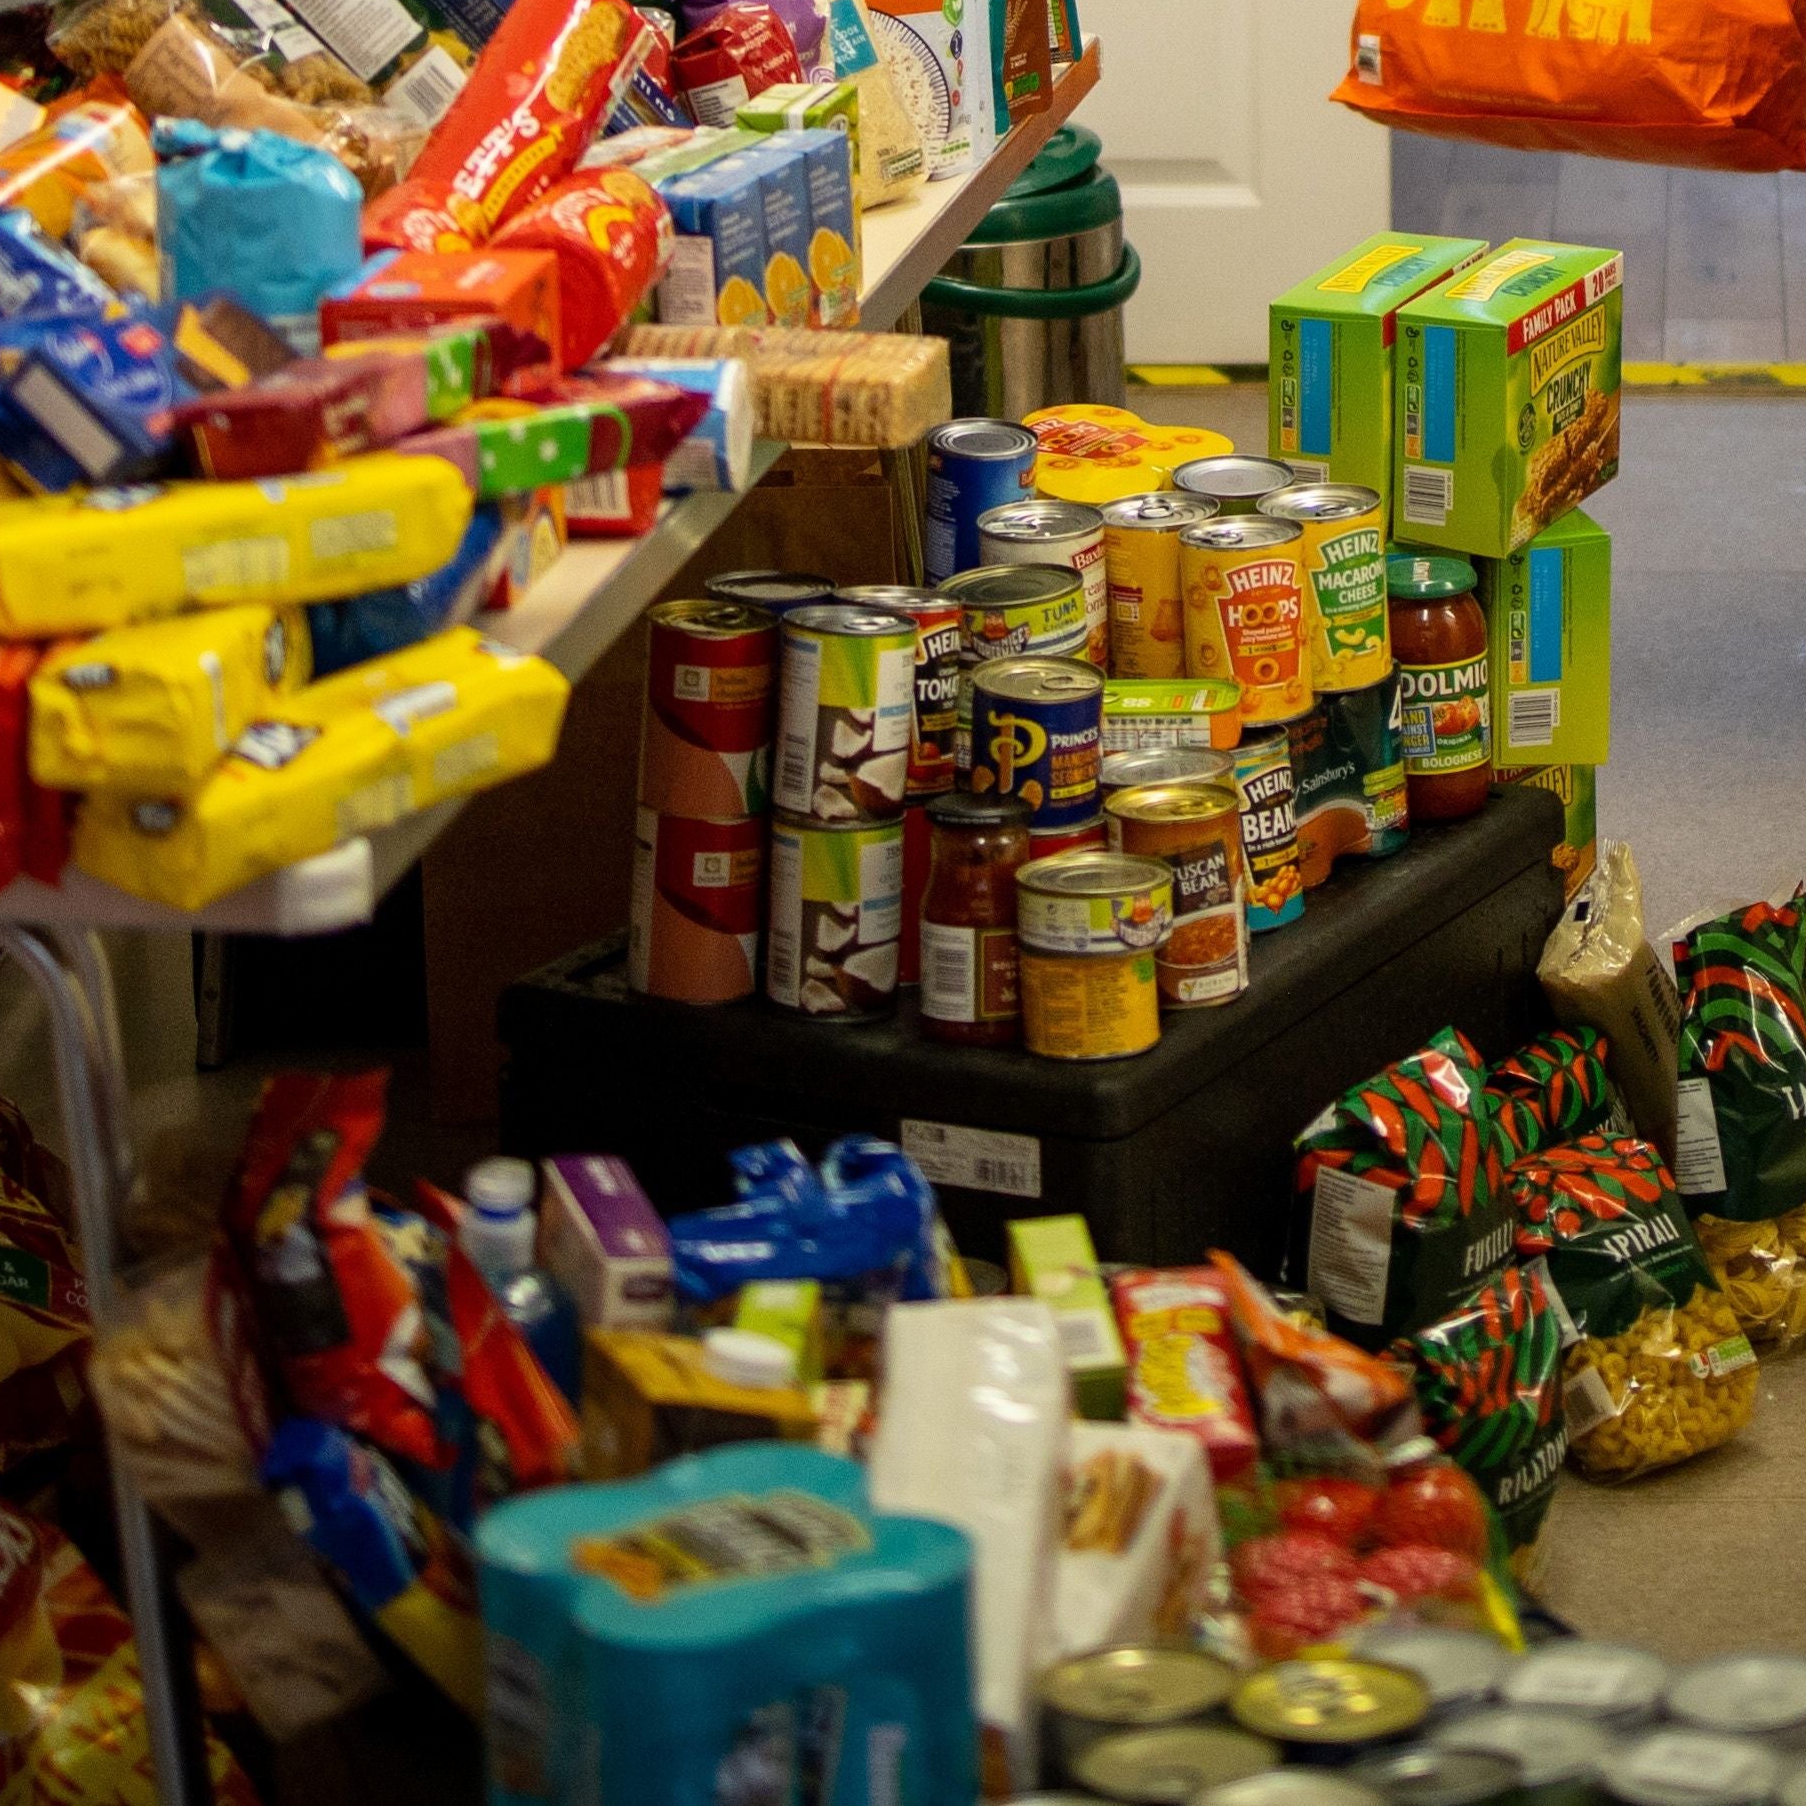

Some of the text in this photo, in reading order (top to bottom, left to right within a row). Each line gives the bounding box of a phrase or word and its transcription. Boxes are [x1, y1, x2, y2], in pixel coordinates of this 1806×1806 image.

[1592, 272, 1605, 298] 20
[1522, 290, 1577, 343] FAMILY PACK
[1533, 308, 1605, 391] NATURE VALLEY
[1546, 359, 1592, 414] CRUNCHY
[1326, 532, 1379, 563] HEINZ
[1232, 565, 1293, 593] HEINZ
[1339, 582, 1377, 604] CHEESE
[1041, 598, 1078, 622] TUNA
[1228, 596, 1299, 627] HOOPS
[1400, 662, 1488, 699] DOLMIO
[1401, 708, 1427, 725] AND
[1051, 729, 1098, 750] PRINCES
[1437, 732, 1472, 746] ORIGINAL
[1422, 748, 1483, 770] BOLOGNESE
[1303, 761, 1355, 795] Sainsbury's
[1242, 800, 1294, 843] BEAN
[1181, 872, 1220, 896] BEAN
[4, 1260, 15, 1272] &
